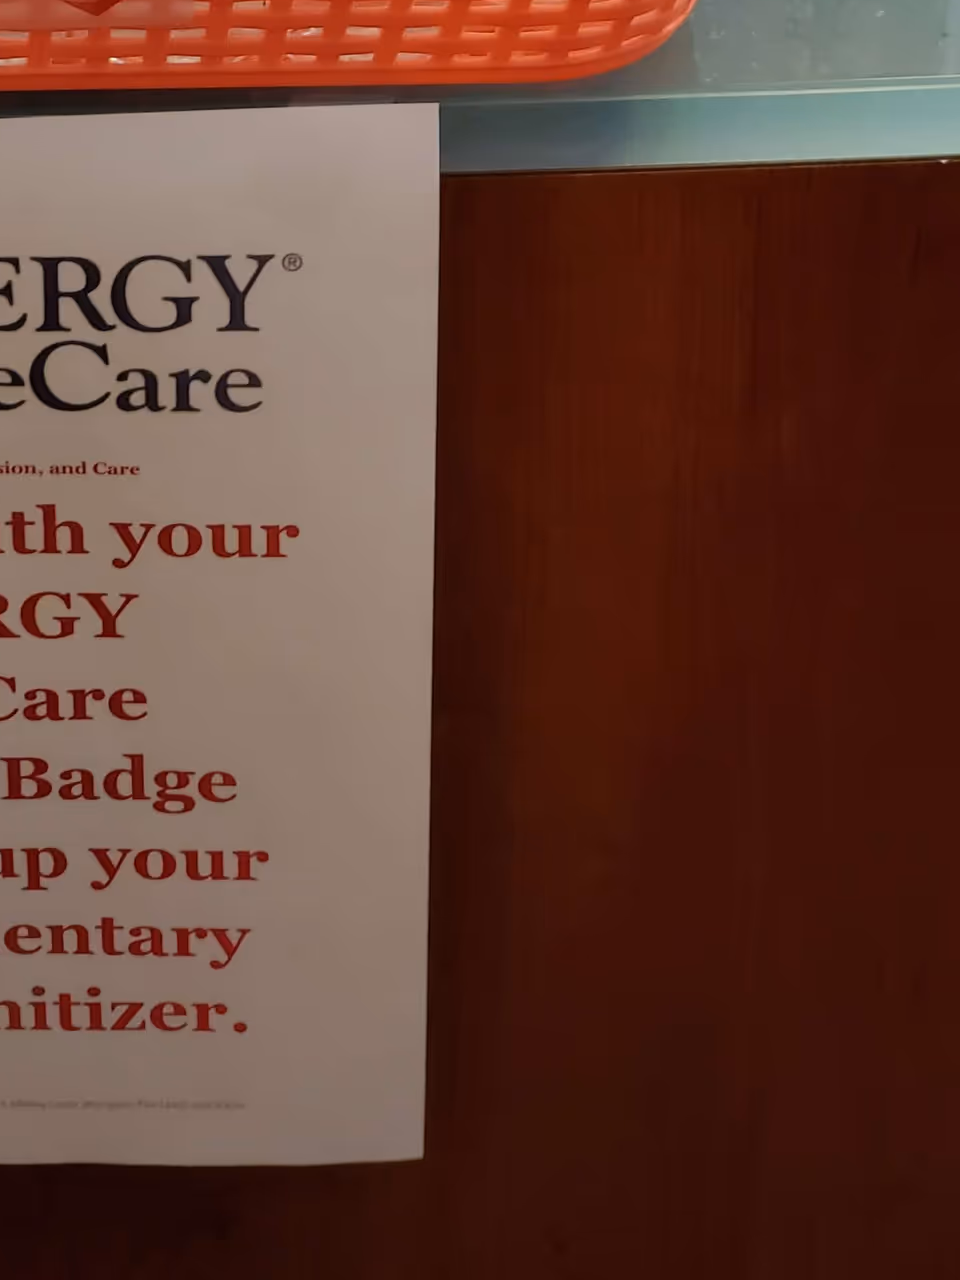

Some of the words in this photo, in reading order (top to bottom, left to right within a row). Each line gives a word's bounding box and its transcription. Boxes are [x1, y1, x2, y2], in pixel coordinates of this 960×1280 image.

[49, 460, 87, 476] and
[92, 461, 141, 476] Care
[109, 522, 301, 570] your
[0, 753, 238, 815] Badge
[88, 847, 270, 892] your
